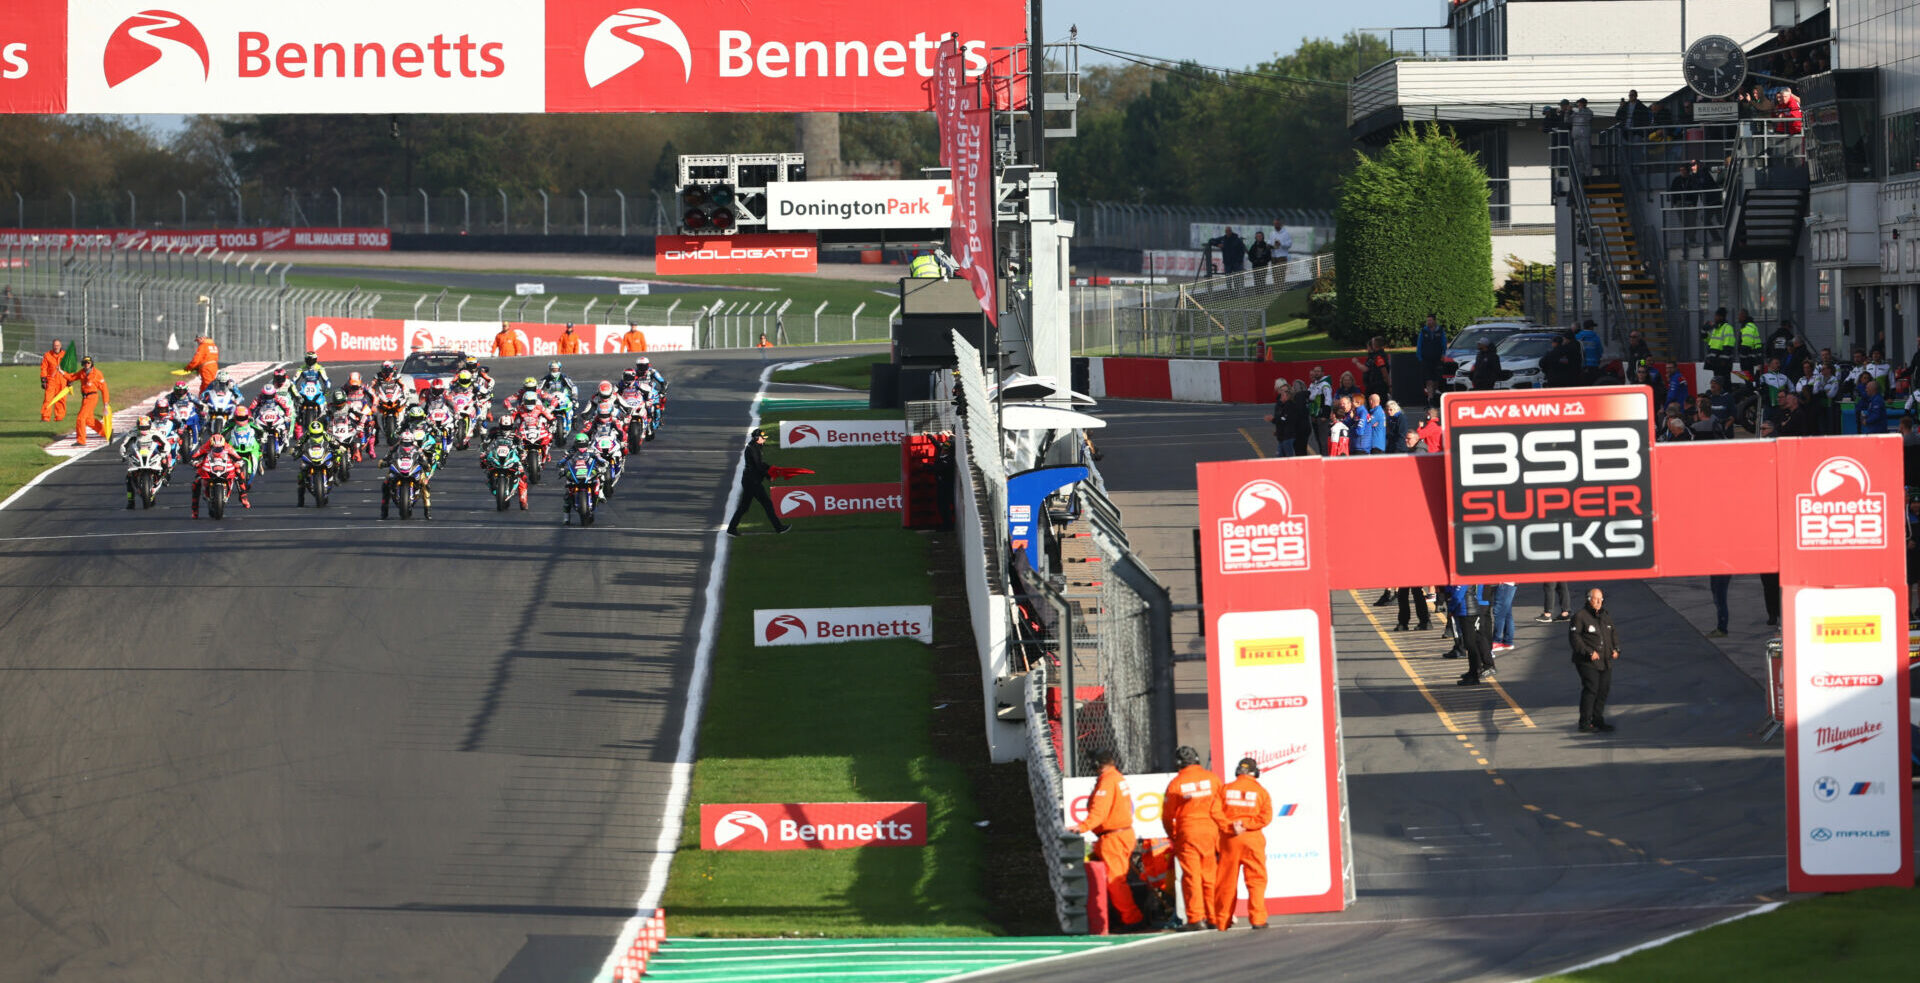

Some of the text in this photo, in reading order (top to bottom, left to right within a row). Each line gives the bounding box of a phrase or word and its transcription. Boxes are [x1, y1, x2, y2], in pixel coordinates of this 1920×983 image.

[239, 31, 505, 79] Bennetts
[780, 198, 930, 220] DoningtonPark
[151, 235, 217, 248] MILWAUKEE
[220, 234, 258, 246] TOOLS
[295, 233, 389, 246] MILWAUKEE TOOLS
[665, 248, 808, 260] OMOLOGATO
[341, 332, 398, 351] Bennetts
[533, 337, 590, 356] Bents
[1457, 403, 1560, 419] PLAY & WIN
[827, 429, 905, 443] Bennetts
[1458, 427, 1642, 487] BSB
[824, 495, 903, 511] Bennett
[1462, 485, 1643, 522] SUPER
[1800, 498, 1882, 514] Bennetts
[1222, 520, 1304, 538] Bennetts
[1801, 514, 1882, 540] BSB
[1223, 537, 1305, 563] BSB
[1463, 519, 1644, 563] PICKS
[817, 619, 921, 638] Bennetts
[1816, 622, 1876, 636] PIRELLI
[1239, 644, 1299, 660] PIRELLI
[1813, 675, 1879, 686] QUATTRO
[1238, 697, 1304, 710] QUATTRO
[1813, 720, 1884, 747] Milwaukee
[780, 819, 912, 841] Bennetts
[1836, 830, 1891, 838] MAXUS
